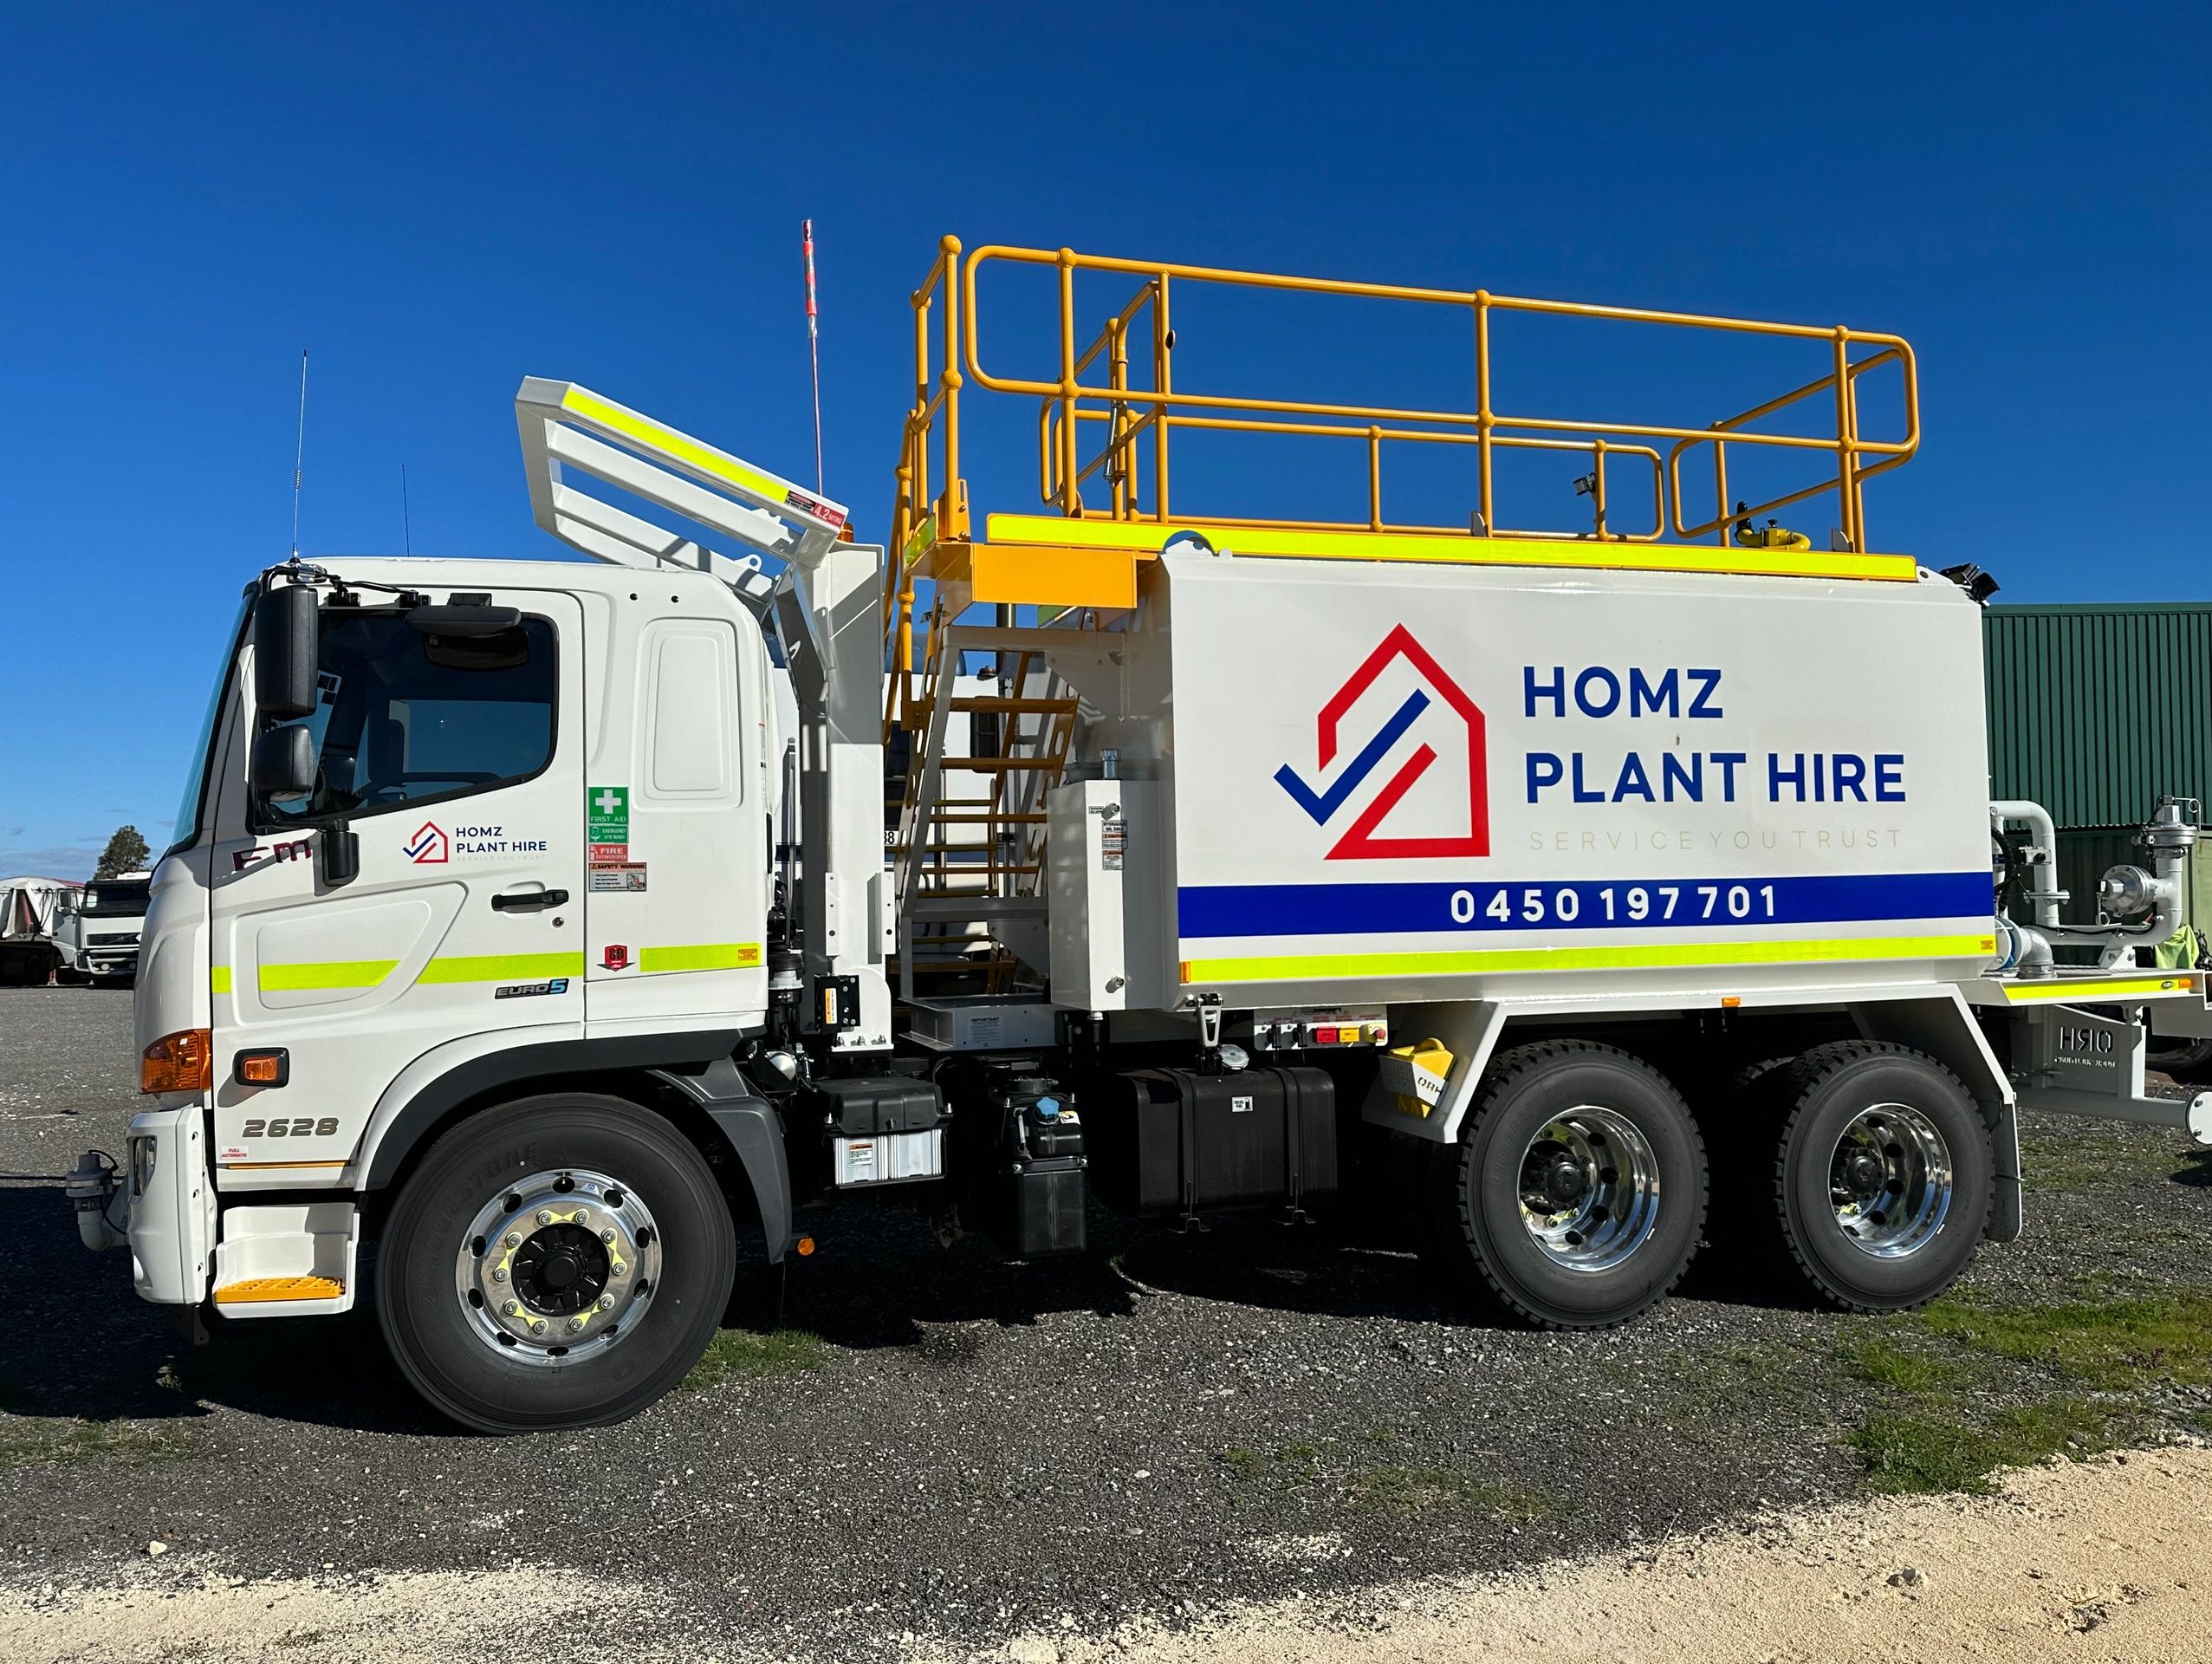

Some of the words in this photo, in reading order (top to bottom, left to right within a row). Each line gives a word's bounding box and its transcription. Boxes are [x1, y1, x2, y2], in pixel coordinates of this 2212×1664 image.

[814, 505, 830, 521] 4.2
[1524, 666, 1723, 718] HOMZ
[1526, 751, 1747, 803] PLANT
[1768, 753, 1905, 803] HIRE
[456, 827, 503, 837] HOMZ
[1529, 830, 1693, 851] SERVICE
[1709, 830, 1777, 850] YOU
[1793, 829, 1903, 849] TRUST
[457, 842, 508, 853] PLANT
[512, 841, 547, 852] HIRE
[1450, 889, 1579, 923] 0450
[1600, 887, 1678, 920] 197
[1697, 885, 1774, 918] 701
[242, 1117, 340, 1137] 2628
